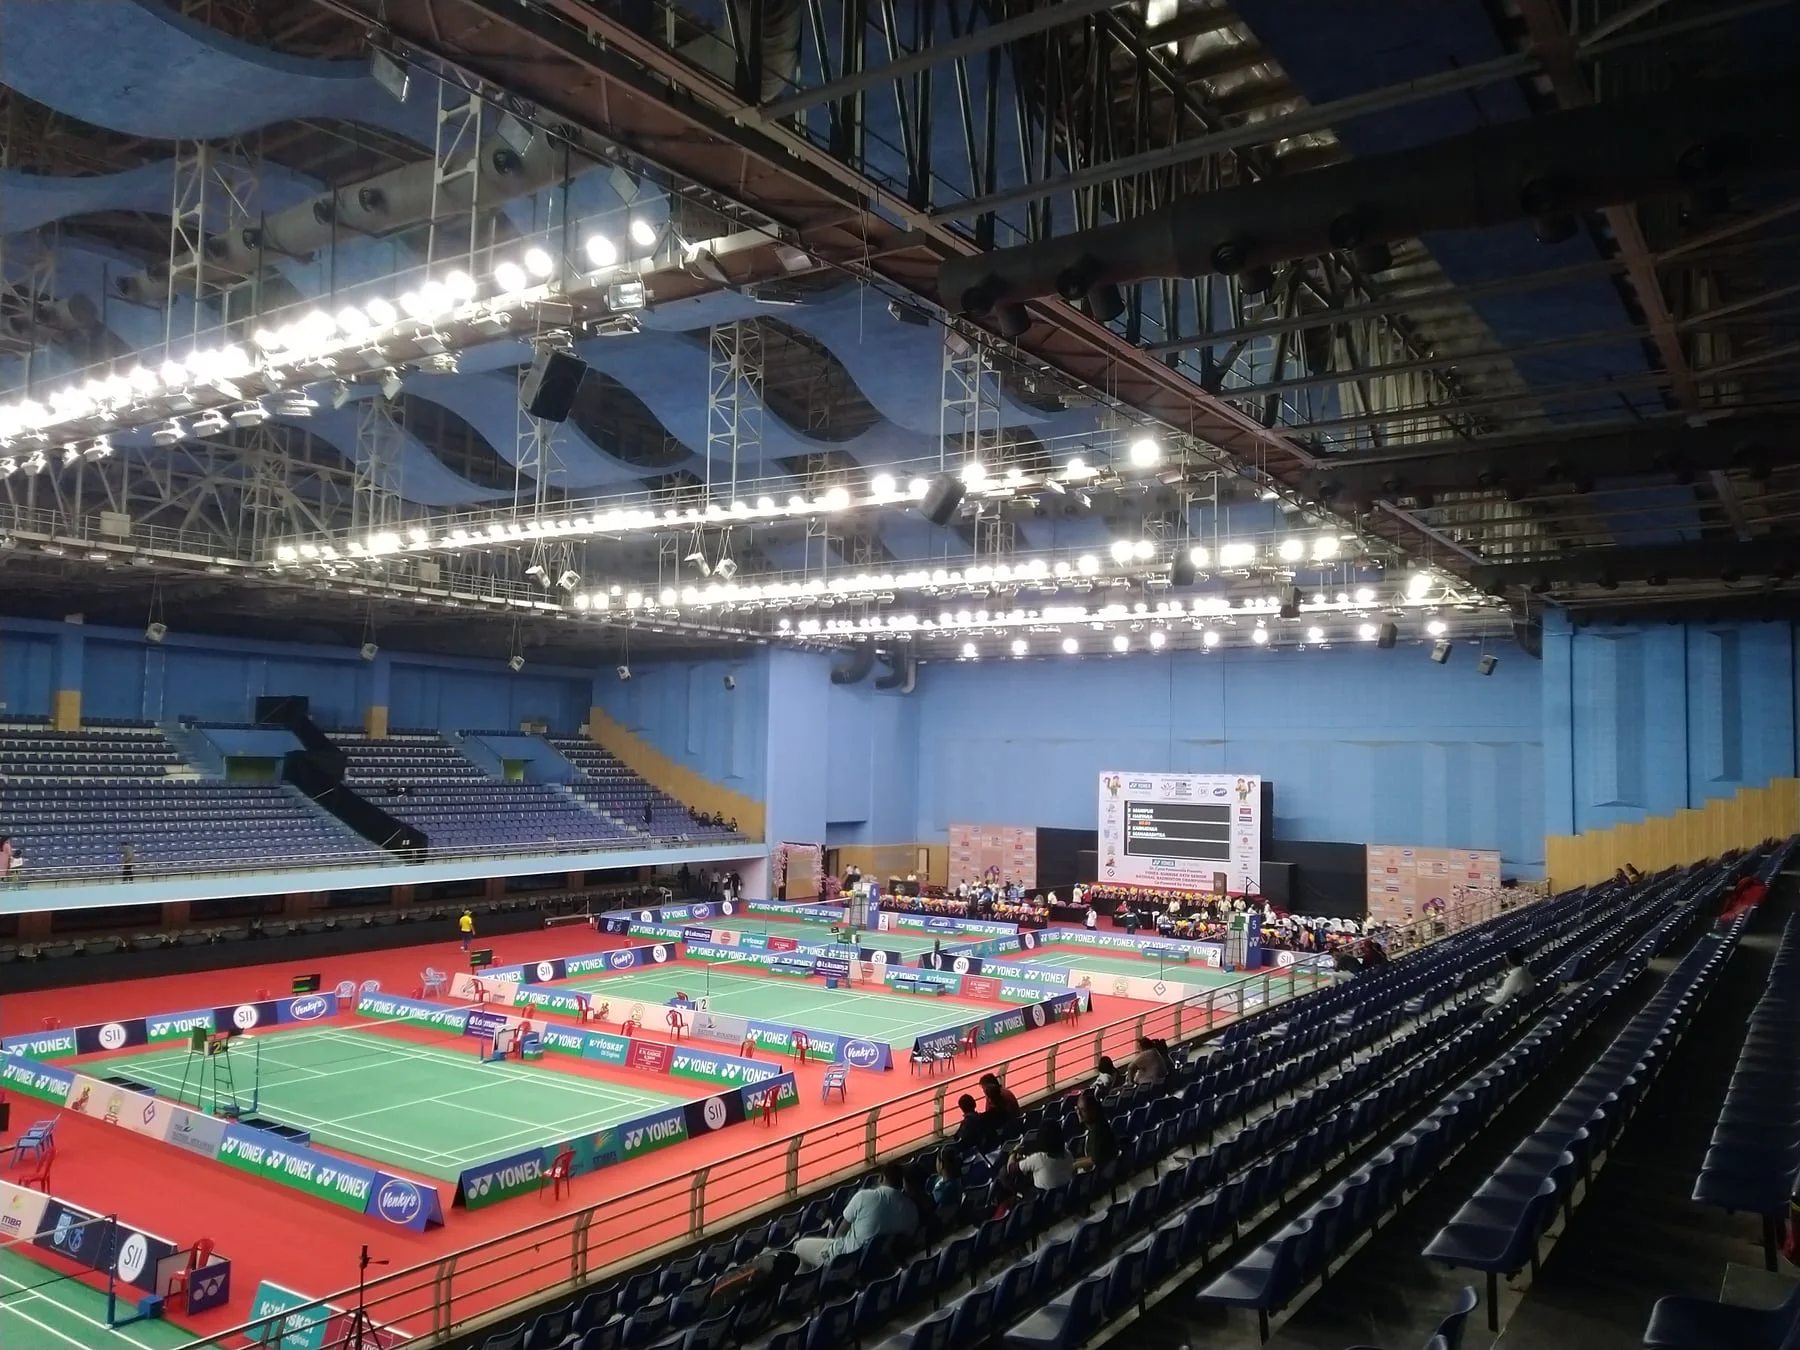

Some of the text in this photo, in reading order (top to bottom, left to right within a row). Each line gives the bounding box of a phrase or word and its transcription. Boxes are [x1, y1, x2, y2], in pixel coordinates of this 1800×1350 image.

[640, 926, 655, 934] YONEX
[1252, 920, 1257, 930] 5
[666, 929, 682, 937] YONEX
[1074, 933, 1096, 944] YONEX
[1113, 938, 1135, 948] YONEX
[697, 948, 714, 957] YONEX
[728, 950, 747, 960] YONEX
[1212, 950, 1217, 959] 2
[581, 958, 604, 970] YONEX
[956, 961, 966, 970] SII
[1281, 955, 1292, 964] SII
[540, 967, 551, 976] SII
[997, 966, 1021, 978] YONEX
[1040, 972, 1066, 984] YONEX
[529, 992, 551, 1005] YONEX
[1016, 989, 1040, 999] YONEX
[295, 997, 323, 1016] Venky's
[372, 1000, 395, 1015] YONEX
[702, 999, 707, 1010] 2
[238, 1010, 253, 1022] SII
[443, 1013, 466, 1028] YONEX
[1005, 1015, 1024, 1031] YONEX
[104, 1030, 121, 1042] SII
[558, 1035, 582, 1049] YONEX
[762, 1031, 789, 1046] YONEX
[30, 1037, 72, 1054] YONEX
[213, 1041, 222, 1054] 2
[847, 1045, 875, 1058] Venky's
[690, 1059, 718, 1075] YONEX
[13, 1068, 37, 1085] YONEX
[47, 1078, 71, 1097] YONEX
[709, 1103, 723, 1120] SII
[646, 1117, 682, 1142] YONEX
[237, 1141, 267, 1164] YONEX
[283, 1154, 315, 1180] YONEX
[495, 1160, 543, 1190] YONEX
[335, 1173, 369, 1199] YONEX
[382, 1188, 417, 1213] Venky's
[124, 1245, 143, 1268] SII
